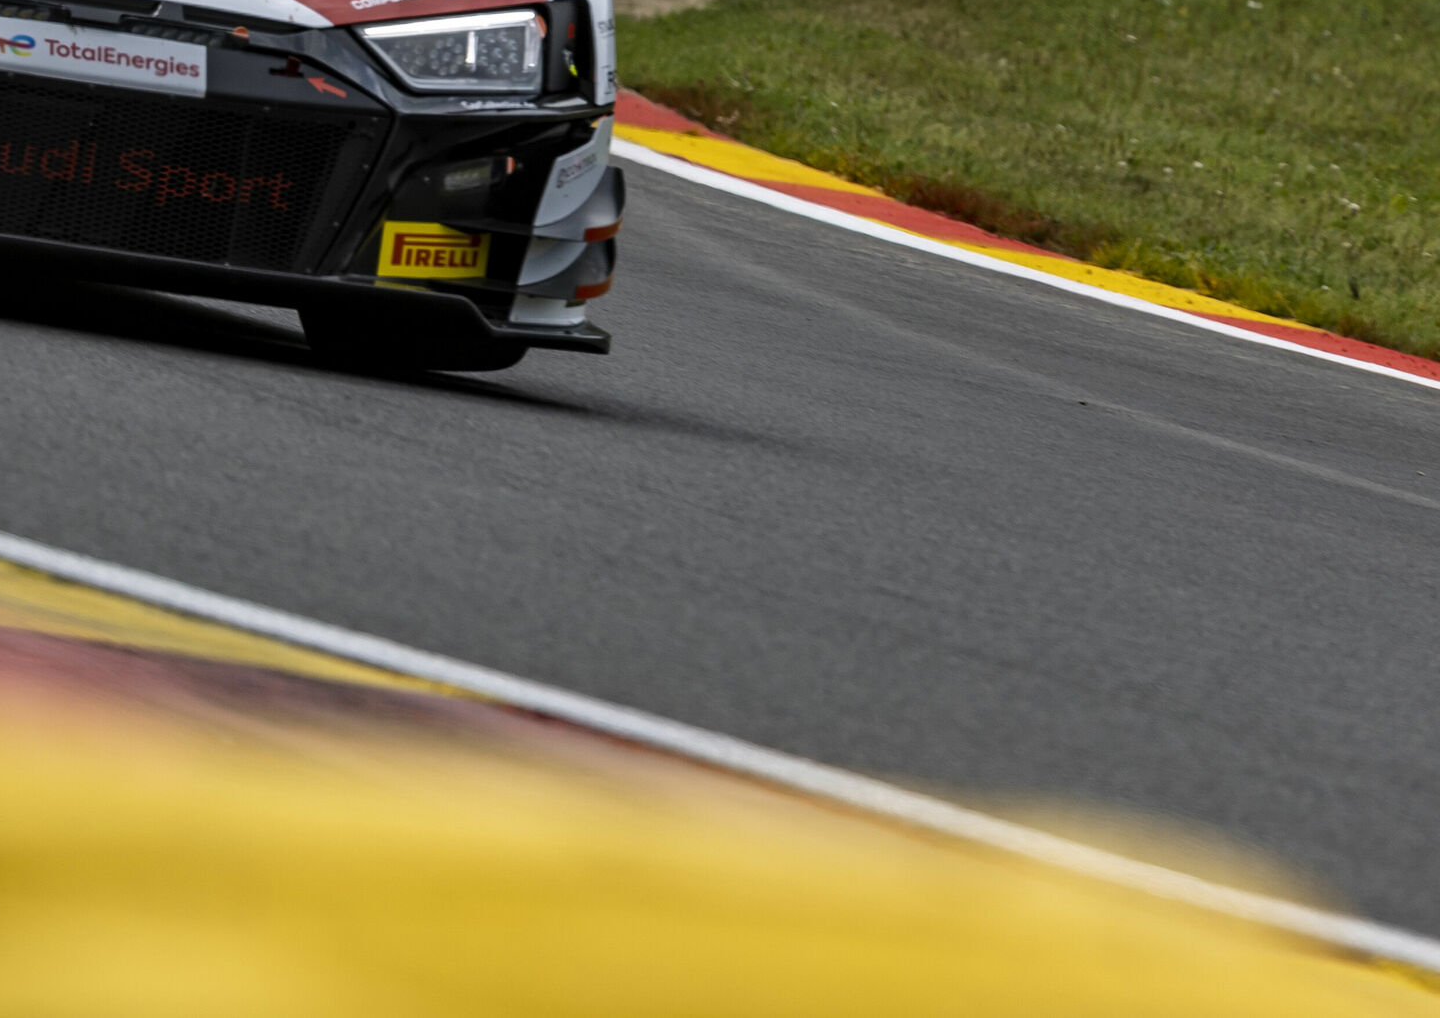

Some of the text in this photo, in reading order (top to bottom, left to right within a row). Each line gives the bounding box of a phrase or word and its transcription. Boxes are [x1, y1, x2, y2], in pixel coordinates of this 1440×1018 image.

[45, 38, 200, 77] TotalEnergies
[116, 147, 293, 211] Sport
[391, 232, 482, 269] PIRELLI
